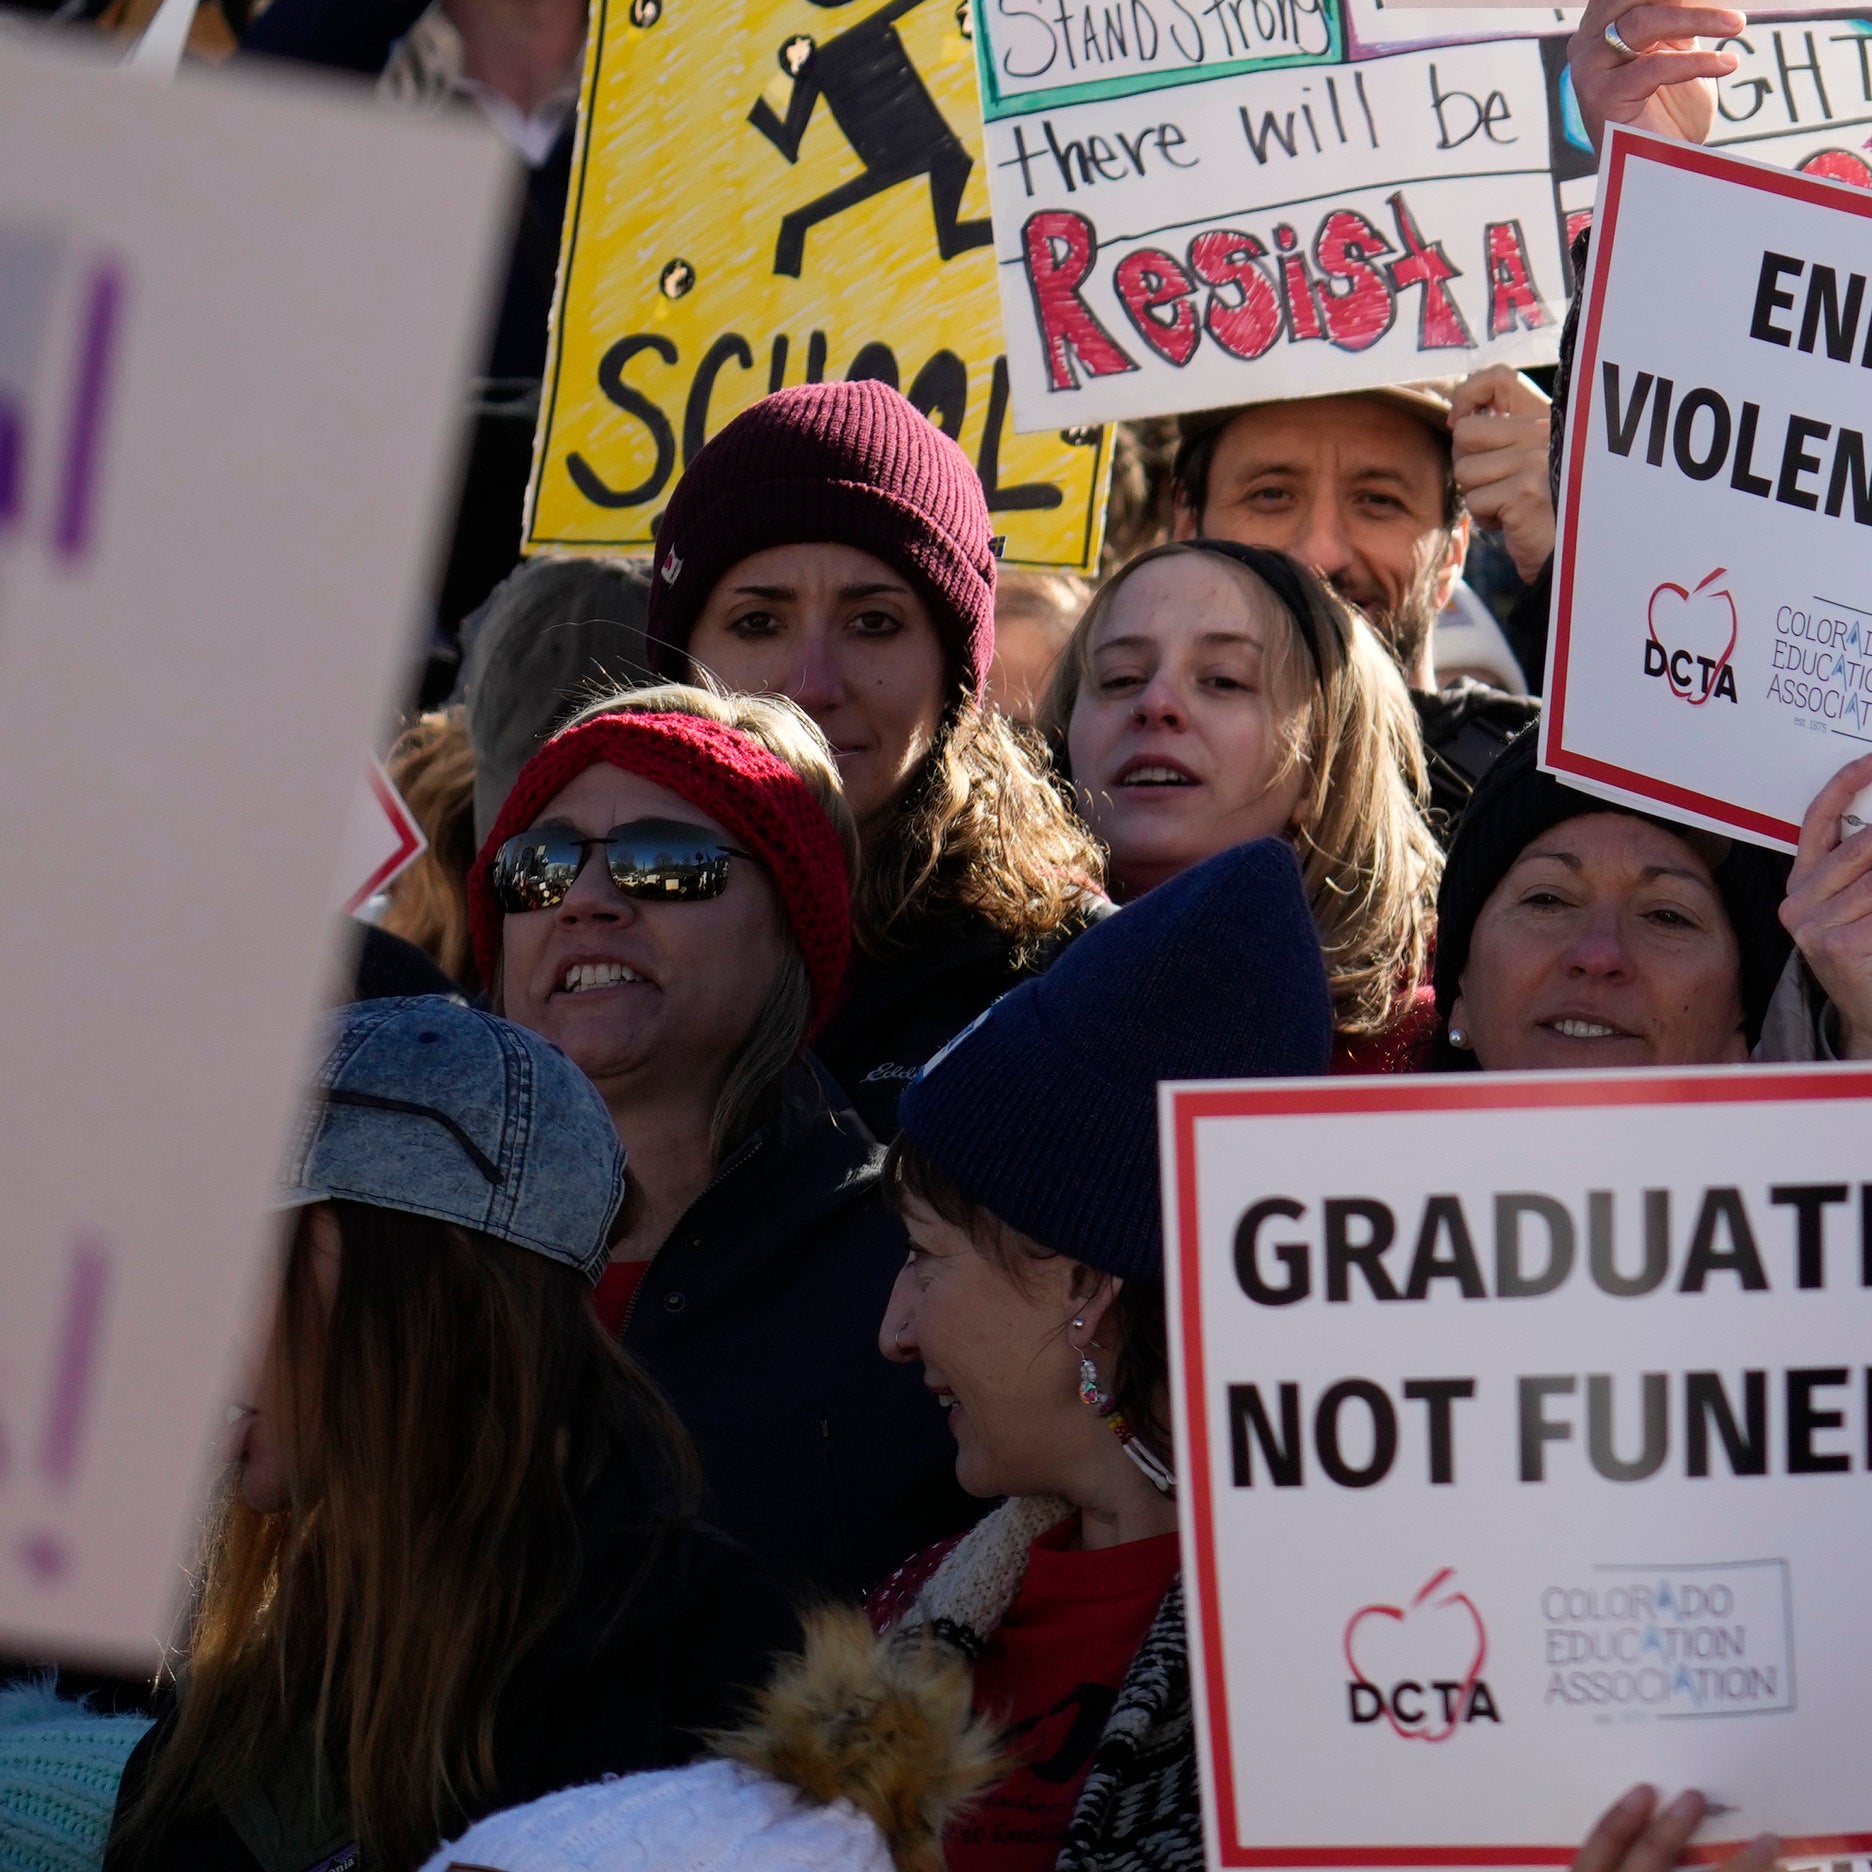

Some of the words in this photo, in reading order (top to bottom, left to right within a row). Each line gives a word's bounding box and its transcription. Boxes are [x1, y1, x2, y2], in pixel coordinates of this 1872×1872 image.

[1000, 120, 1200, 197] there
[1240, 65, 1376, 164] will
[1431, 60, 1520, 146] be
[1643, 638, 1738, 704] DCTA
[859, 1061, 917, 1084] Edd
[1225, 1376, 1477, 1490] NOT
[1540, 1579, 1734, 1624] COLORADO
[1545, 1624, 1746, 1665] EDUCATION
[1347, 1680, 1501, 1726] DCTA
[1543, 1664, 1777, 1705] ASSOCIATION
